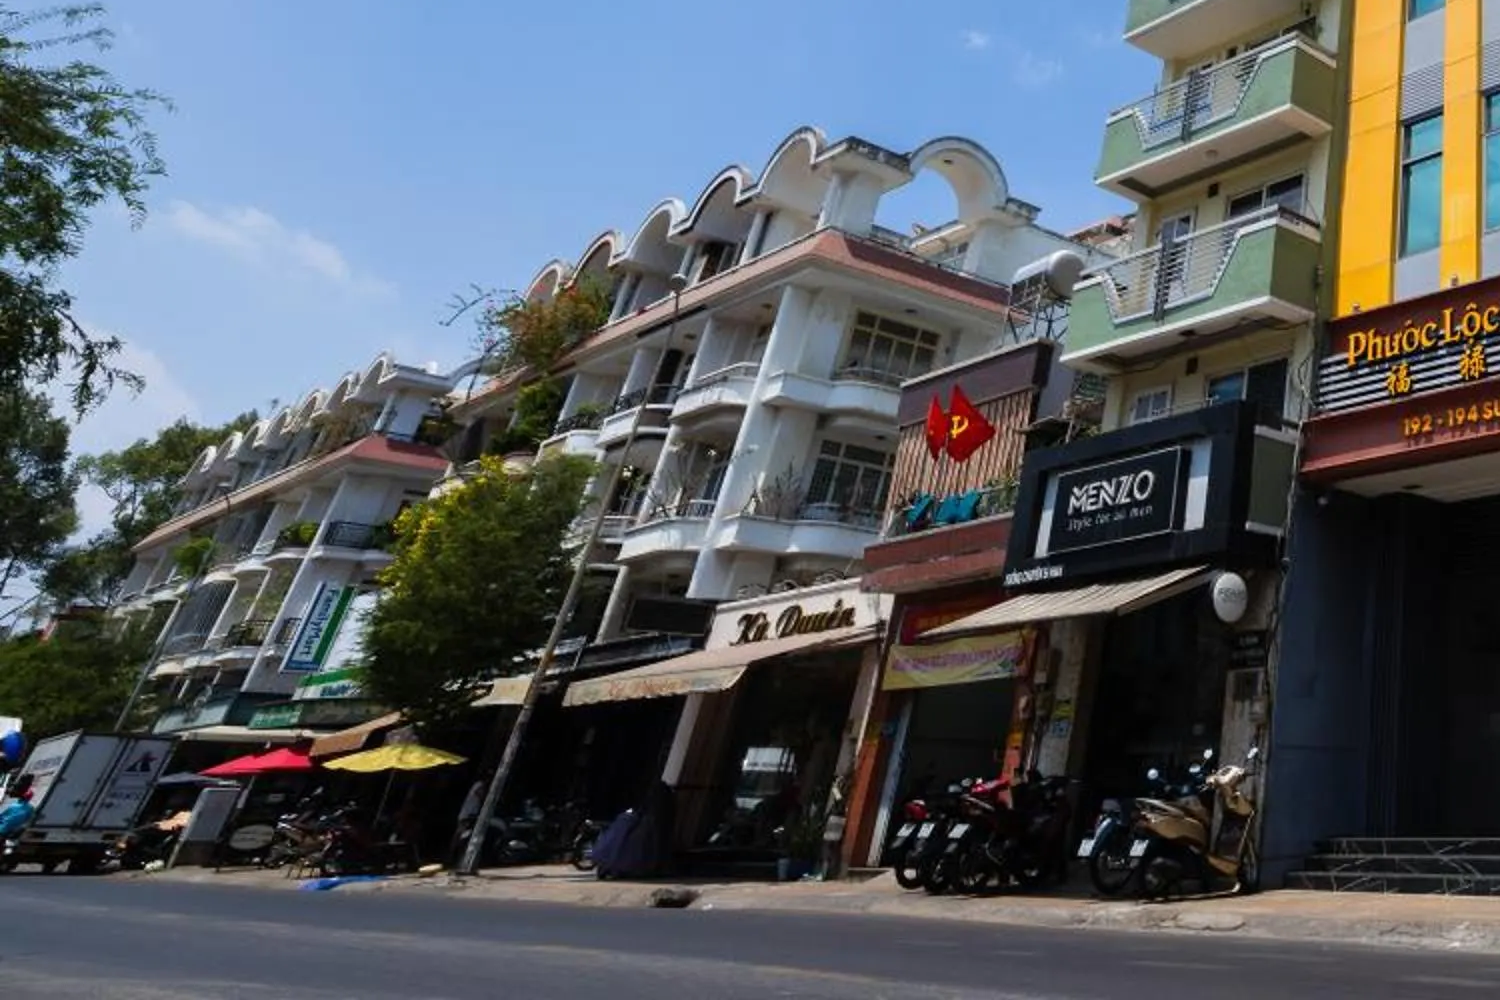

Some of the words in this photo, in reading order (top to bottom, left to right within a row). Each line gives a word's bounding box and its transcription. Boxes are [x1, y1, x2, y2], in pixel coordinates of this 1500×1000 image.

[1347, 318, 1438, 366] Phước
[1442, 302, 1500, 346] Lộc
[1404, 413, 1433, 436] 192
[1448, 404, 1479, 426] 194
[1067, 469, 1155, 516] MENZO
